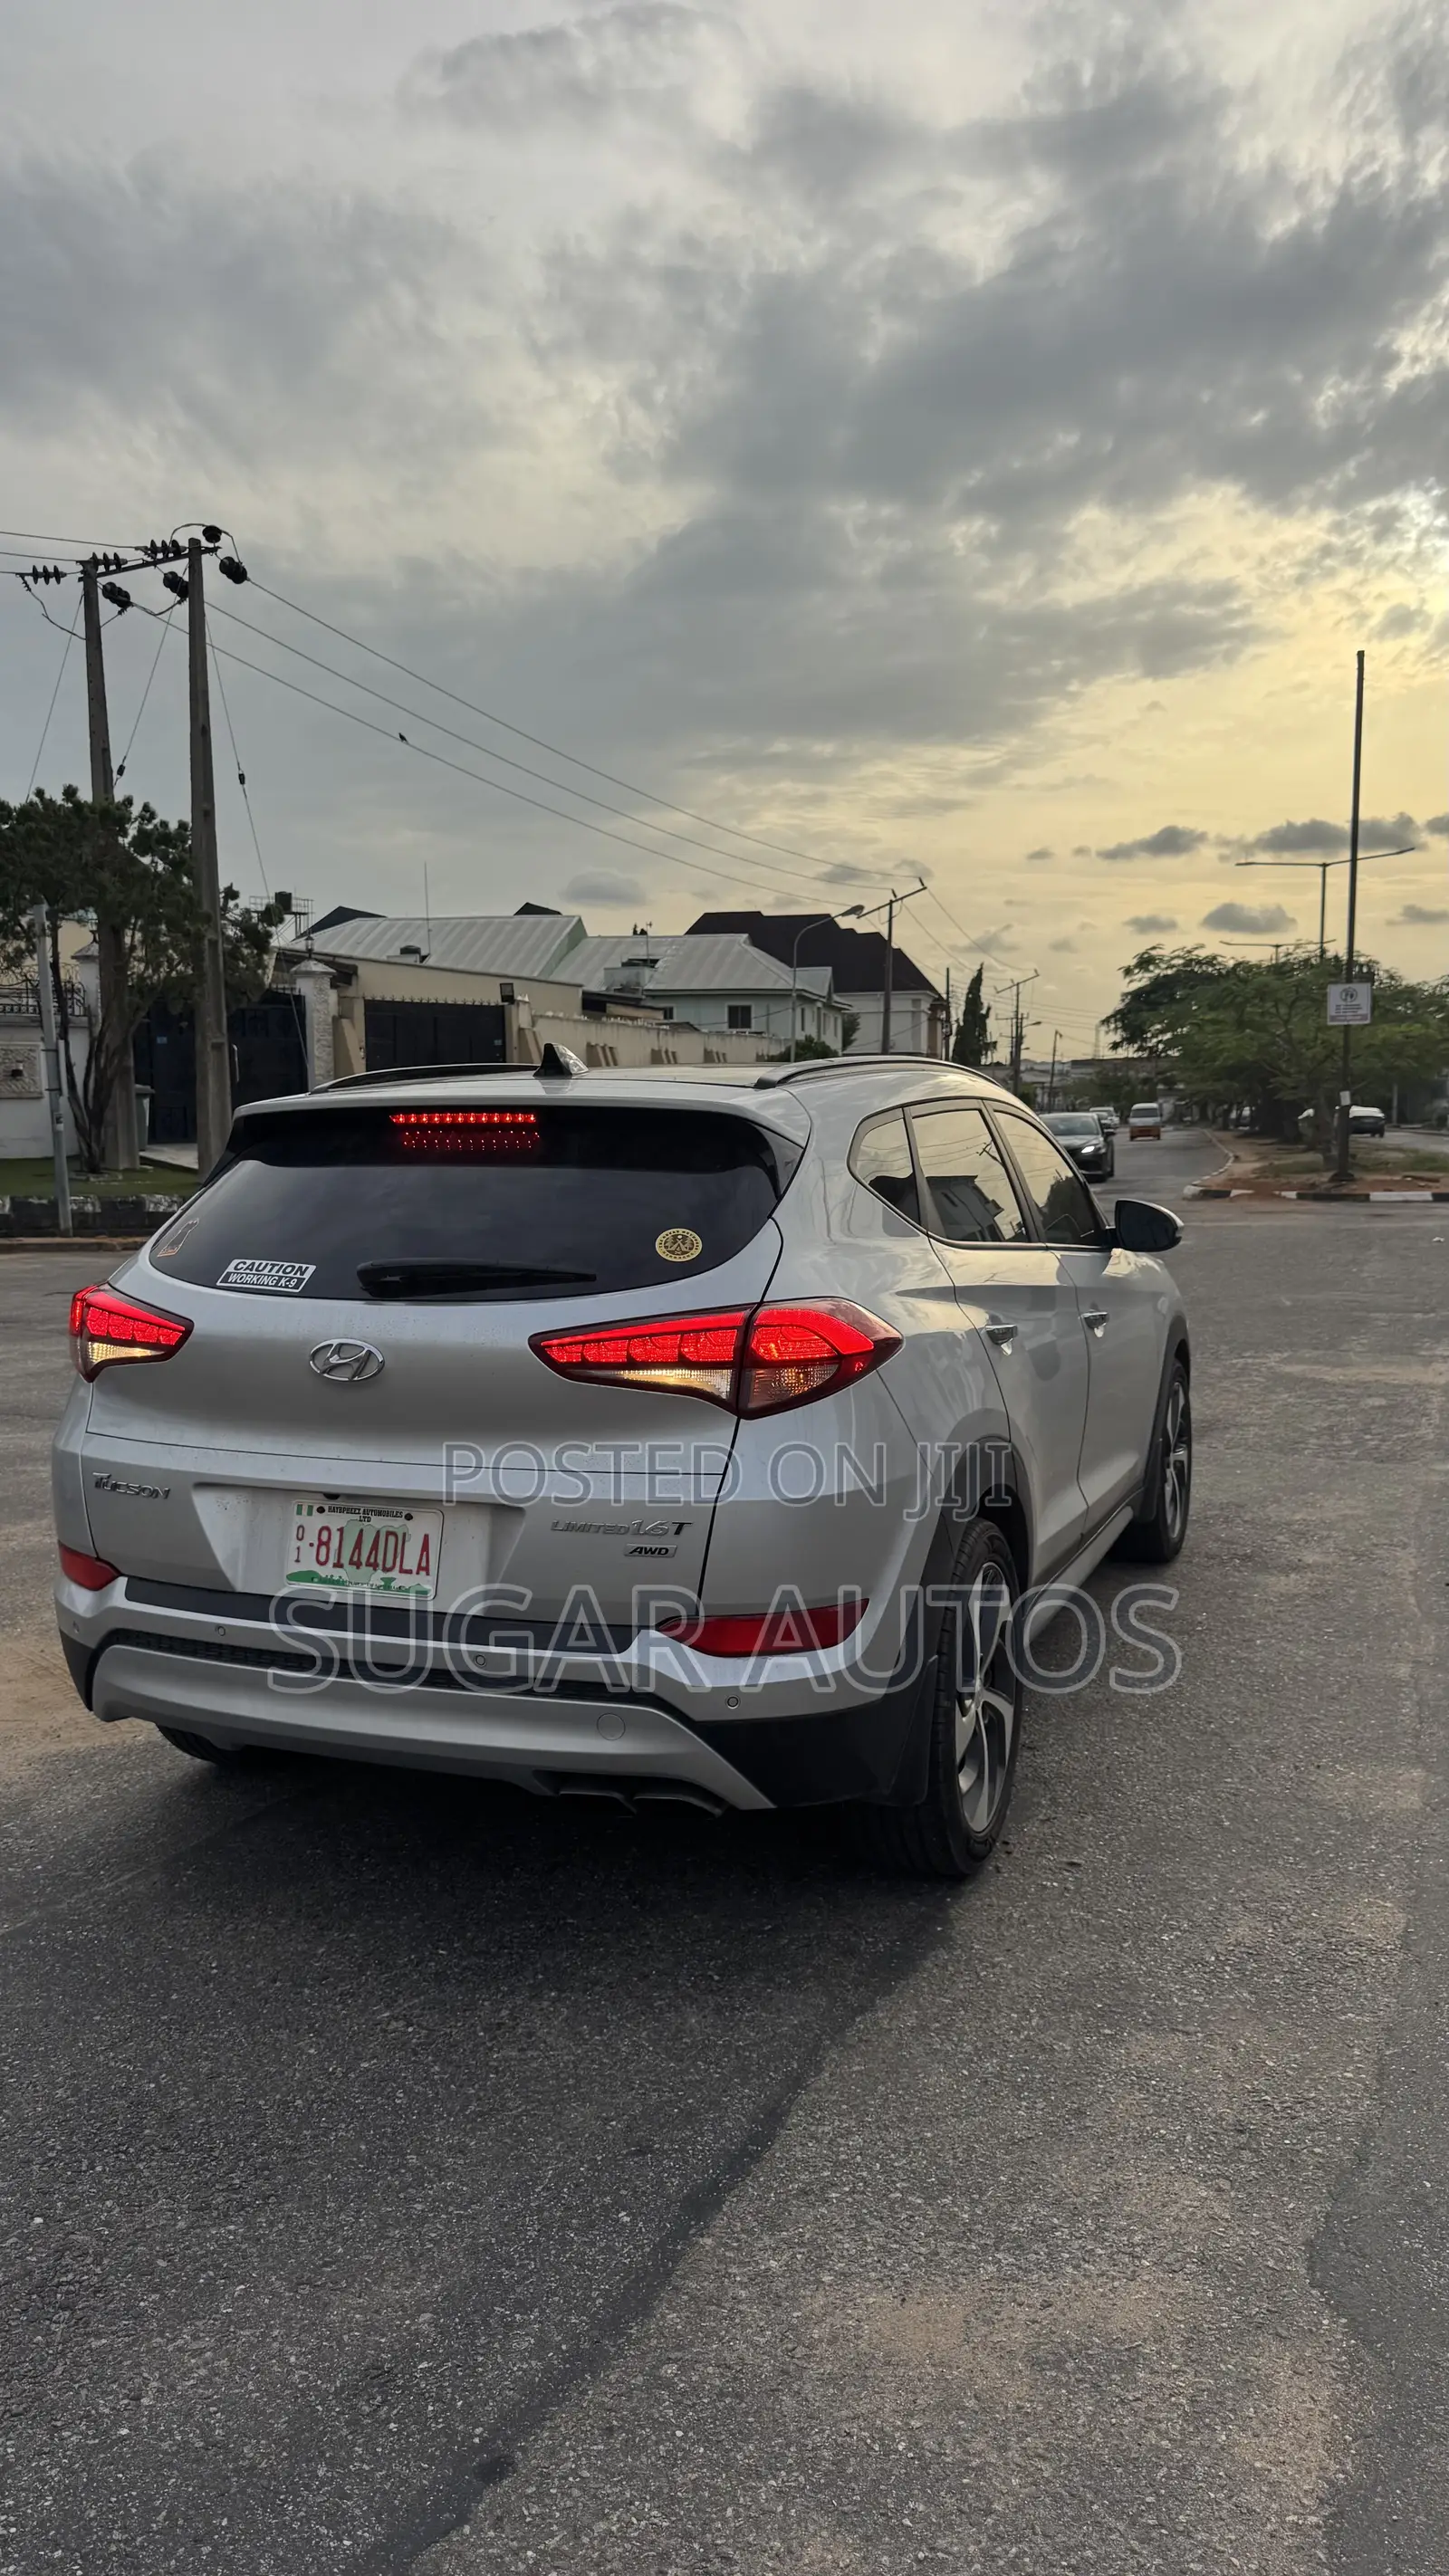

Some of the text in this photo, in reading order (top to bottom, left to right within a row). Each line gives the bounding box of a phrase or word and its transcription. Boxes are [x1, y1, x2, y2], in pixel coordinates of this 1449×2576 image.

[233, 1260, 310, 1277] CAUTION
[228, 1272, 298, 1288] WORKING K-9
[359, 1515, 372, 1523] LTD
[362, 1508, 404, 1518] AUTOMOBILES
[550, 1519, 629, 1535] LIMITED
[629, 1546, 669, 1556] AWD
